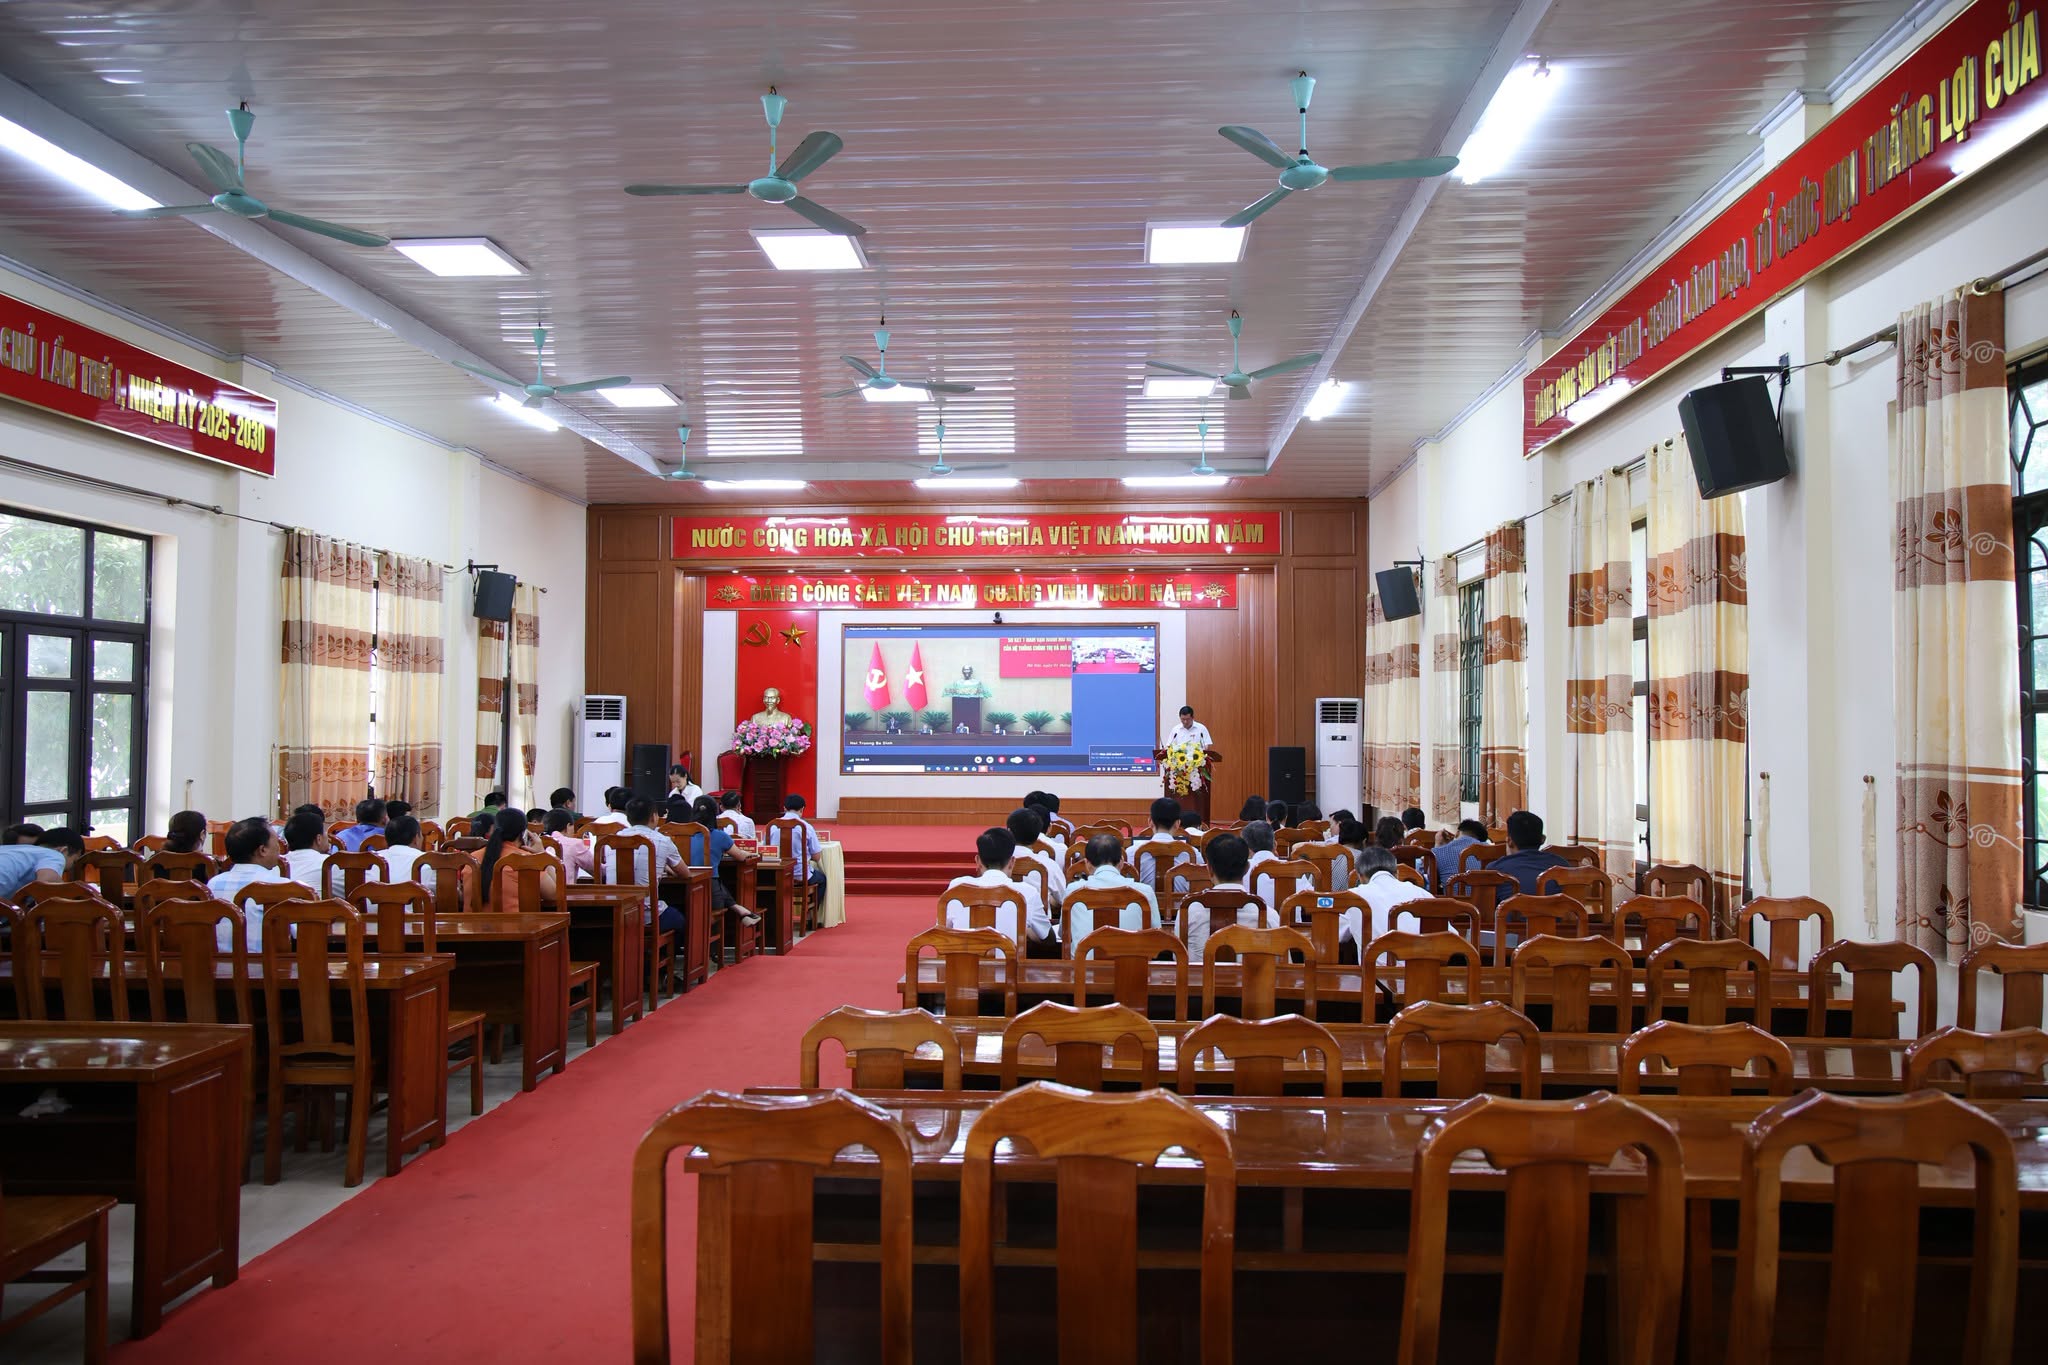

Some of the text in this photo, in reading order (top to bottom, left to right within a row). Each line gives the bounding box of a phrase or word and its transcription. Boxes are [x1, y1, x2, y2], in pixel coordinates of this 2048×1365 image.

[1683, 259, 1717, 324] LÃNH
[1719, 237, 1751, 300] ĐẠO,
[1753, 191, 1775, 275] TỔ
[1776, 175, 1820, 259] CHỨC
[1824, 149, 1858, 226] MỌI
[1863, 91, 1935, 196] THẮNG
[1940, 55, 1979, 144] LỢI
[1985, 0, 2042, 109] CỦA
[0, 322, 37, 376] CHỦ
[41, 335, 77, 390] LẦN
[79, 355, 113, 401] THỨ
[128, 374, 177, 424] NHIỆM
[177, 388, 199, 430] KỲ
[692, 522, 747, 548] NƯỚC
[753, 523, 808, 552] CỘNG
[814, 523, 854, 548] HÒA
[860, 522, 889, 548] XÃ
[895, 523, 929, 551] HỘI
[1049, 521, 1092, 550] VIỆT
[1096, 524, 1145, 545] NAM
[1215, 518, 1264, 544] NĂM
[751, 578, 1193, 607] ĐẢNG CỘNG SẢN VIỆT NAM QUANG VINH MUÔN NĂM
